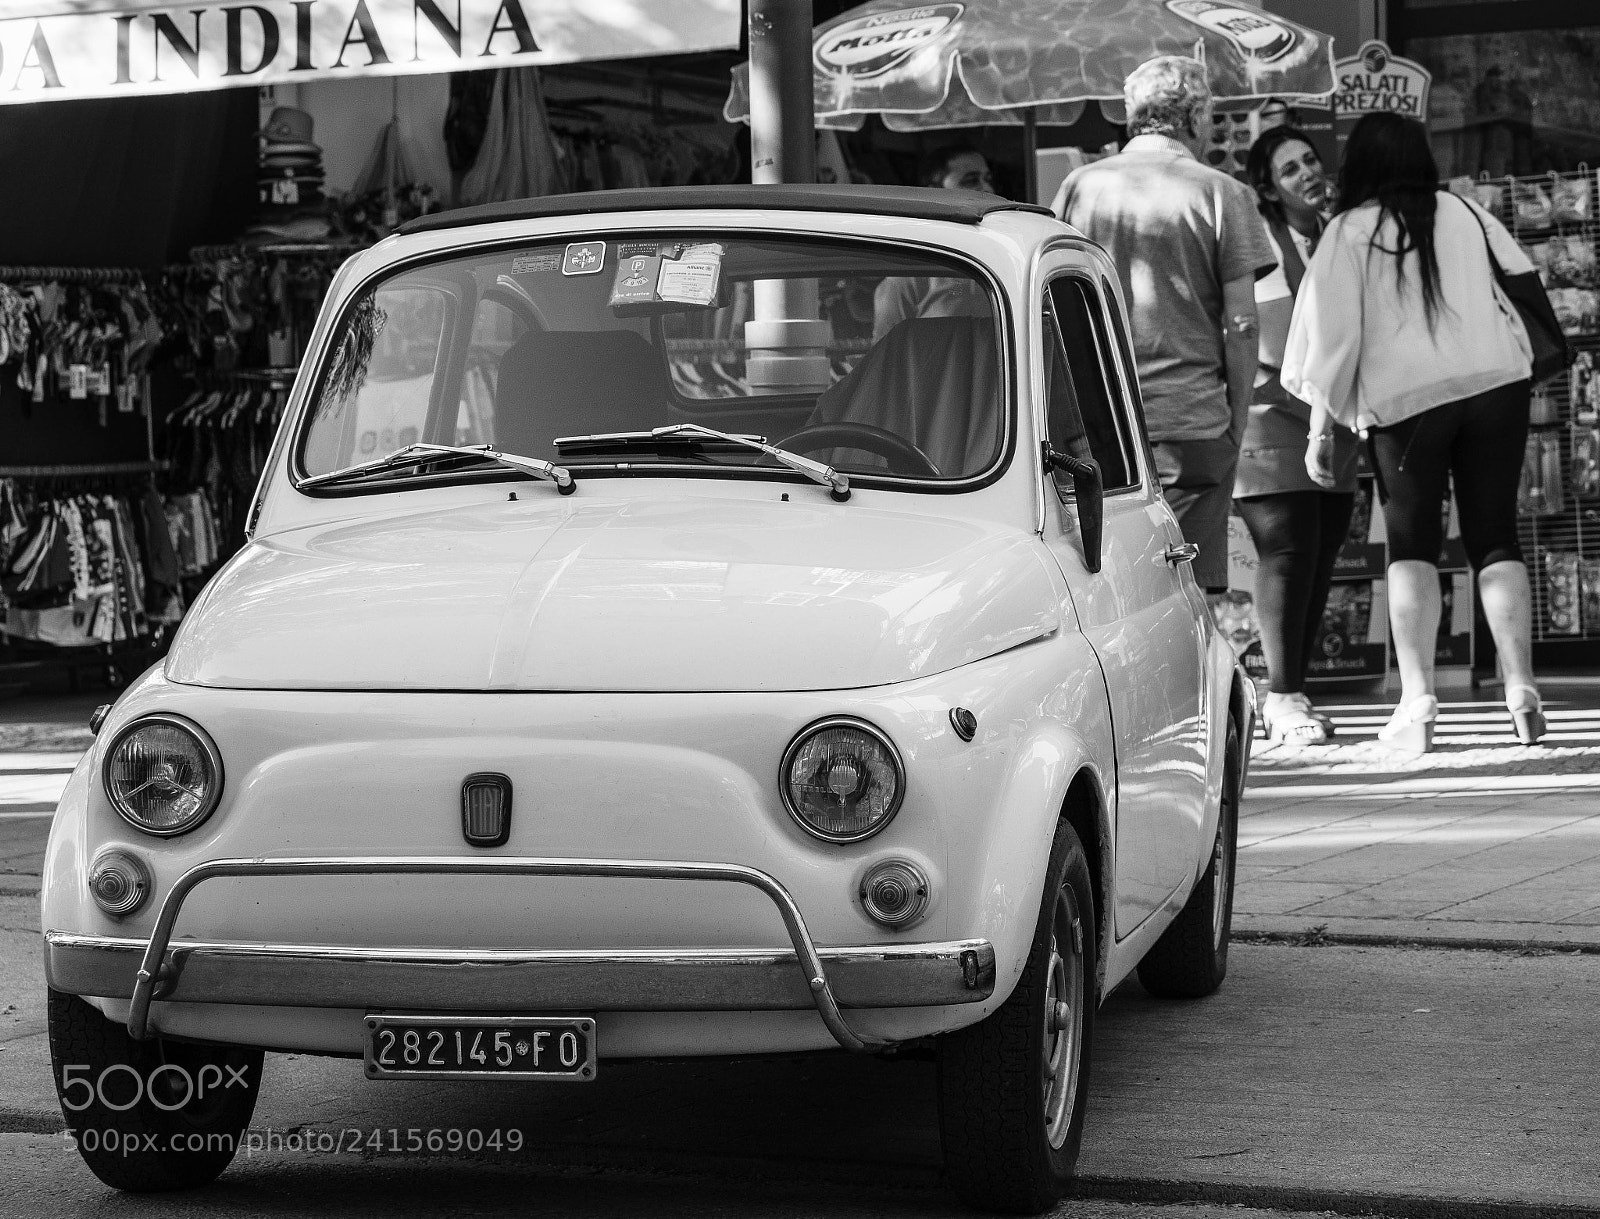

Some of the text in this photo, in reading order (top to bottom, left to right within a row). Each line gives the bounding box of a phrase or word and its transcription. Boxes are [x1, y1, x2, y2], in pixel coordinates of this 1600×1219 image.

[0, 0, 542, 92] A INDIANA
[1341, 74, 1409, 93] SALATI
[1333, 94, 1418, 112] PREZIOSI
[472, 788, 501, 833] FIAT
[379, 1030, 513, 1067] 282145
